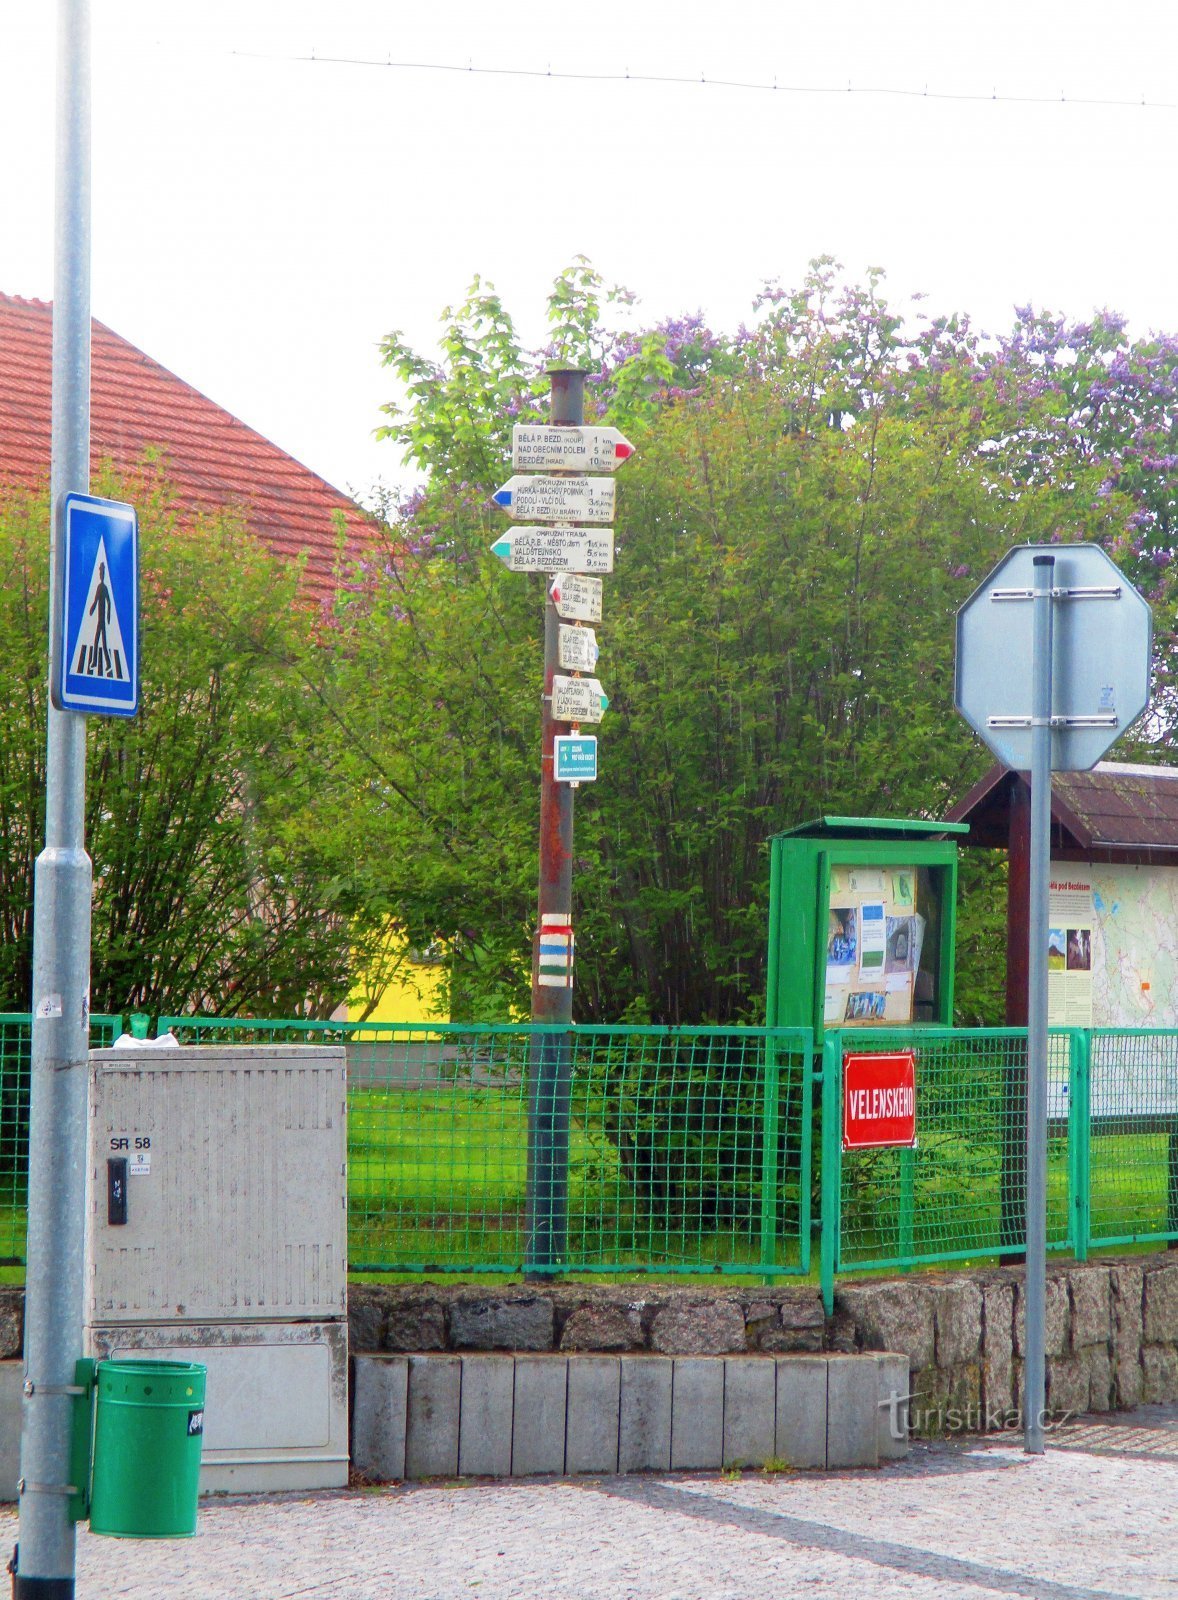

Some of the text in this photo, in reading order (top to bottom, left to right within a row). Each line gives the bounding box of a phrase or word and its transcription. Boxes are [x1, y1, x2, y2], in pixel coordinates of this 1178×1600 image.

[532, 445, 562, 454] OBECNÍM
[849, 1083, 913, 1120] VELENSKÉHO
[110, 1137, 150, 1150] SR 58
